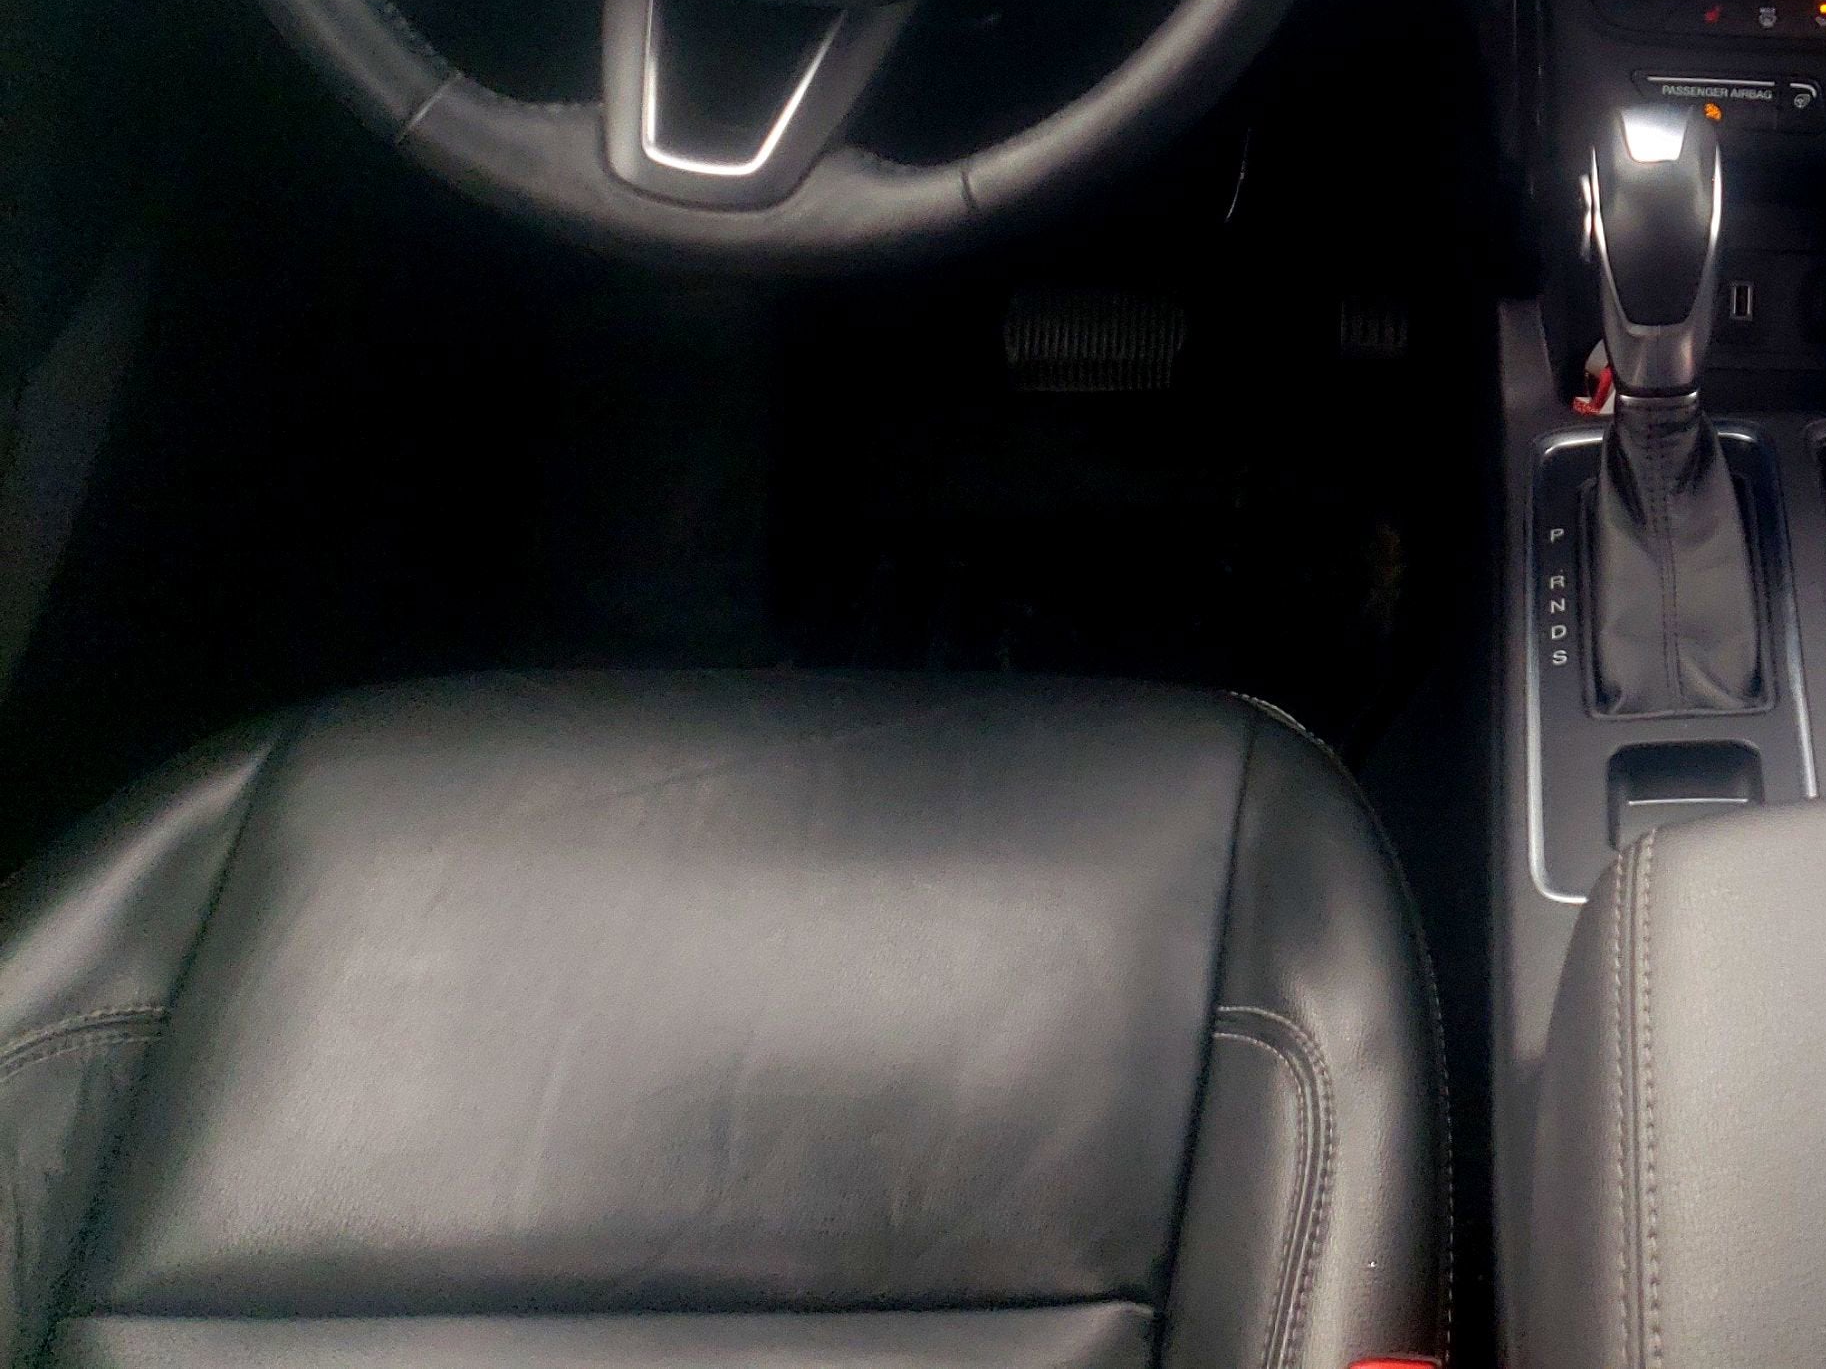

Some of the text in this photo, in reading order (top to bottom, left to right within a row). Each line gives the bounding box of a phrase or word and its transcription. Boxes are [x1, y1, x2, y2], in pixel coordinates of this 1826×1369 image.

[1662, 84, 1773, 100] PASSENGER AIRBAG
[1550, 528, 1564, 542] P
[1550, 575, 1565, 590] R
[1550, 598, 1565, 614] N
[1551, 625, 1567, 640] D
[1552, 649, 1568, 665] S
